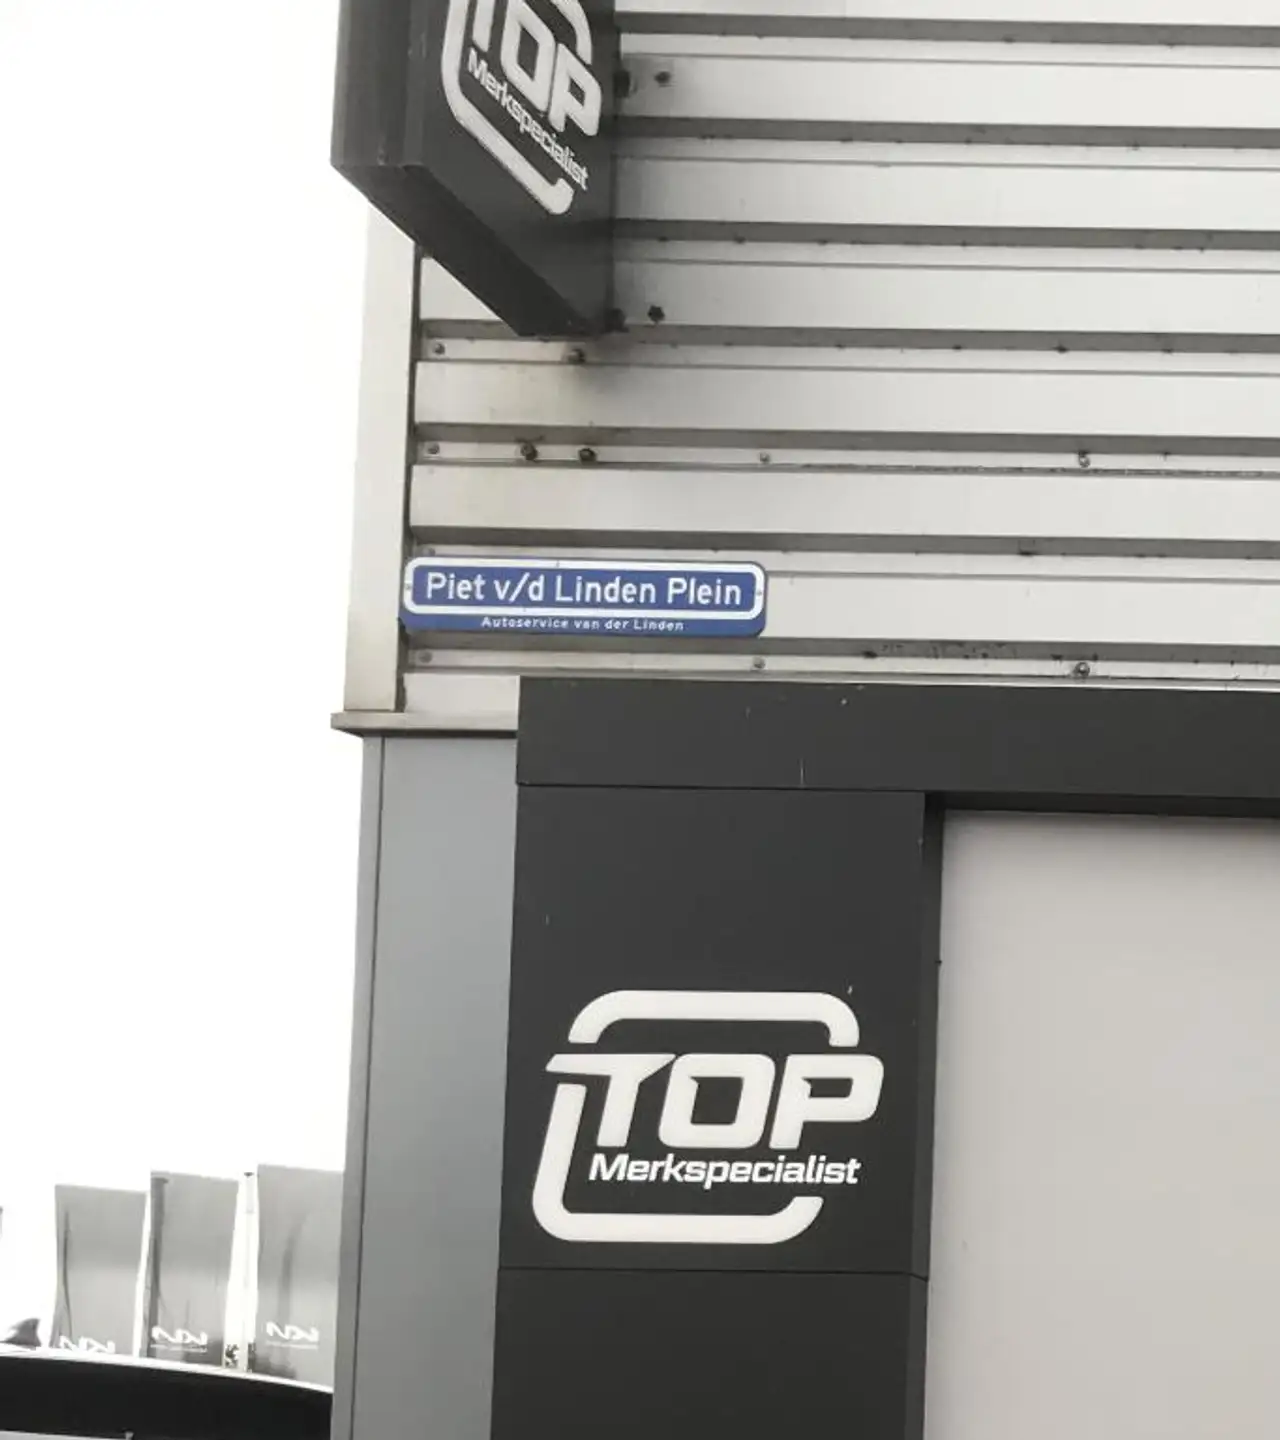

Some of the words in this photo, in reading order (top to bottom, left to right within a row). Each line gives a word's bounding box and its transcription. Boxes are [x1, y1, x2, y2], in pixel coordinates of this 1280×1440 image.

[468, 48, 588, 190] Merkspecialist
[427, 572, 486, 600] Piet
[494, 572, 545, 602] v/d
[555, 575, 656, 603] Linden
[667, 577, 741, 605] Plein
[481, 616, 569, 628] Autoservice
[574, 619, 599, 629] van
[604, 619, 629, 630] der
[633, 620, 684, 631] Linden
[546, 1054, 884, 1149] TOP
[589, 1153, 861, 1189] Merkspecialist
